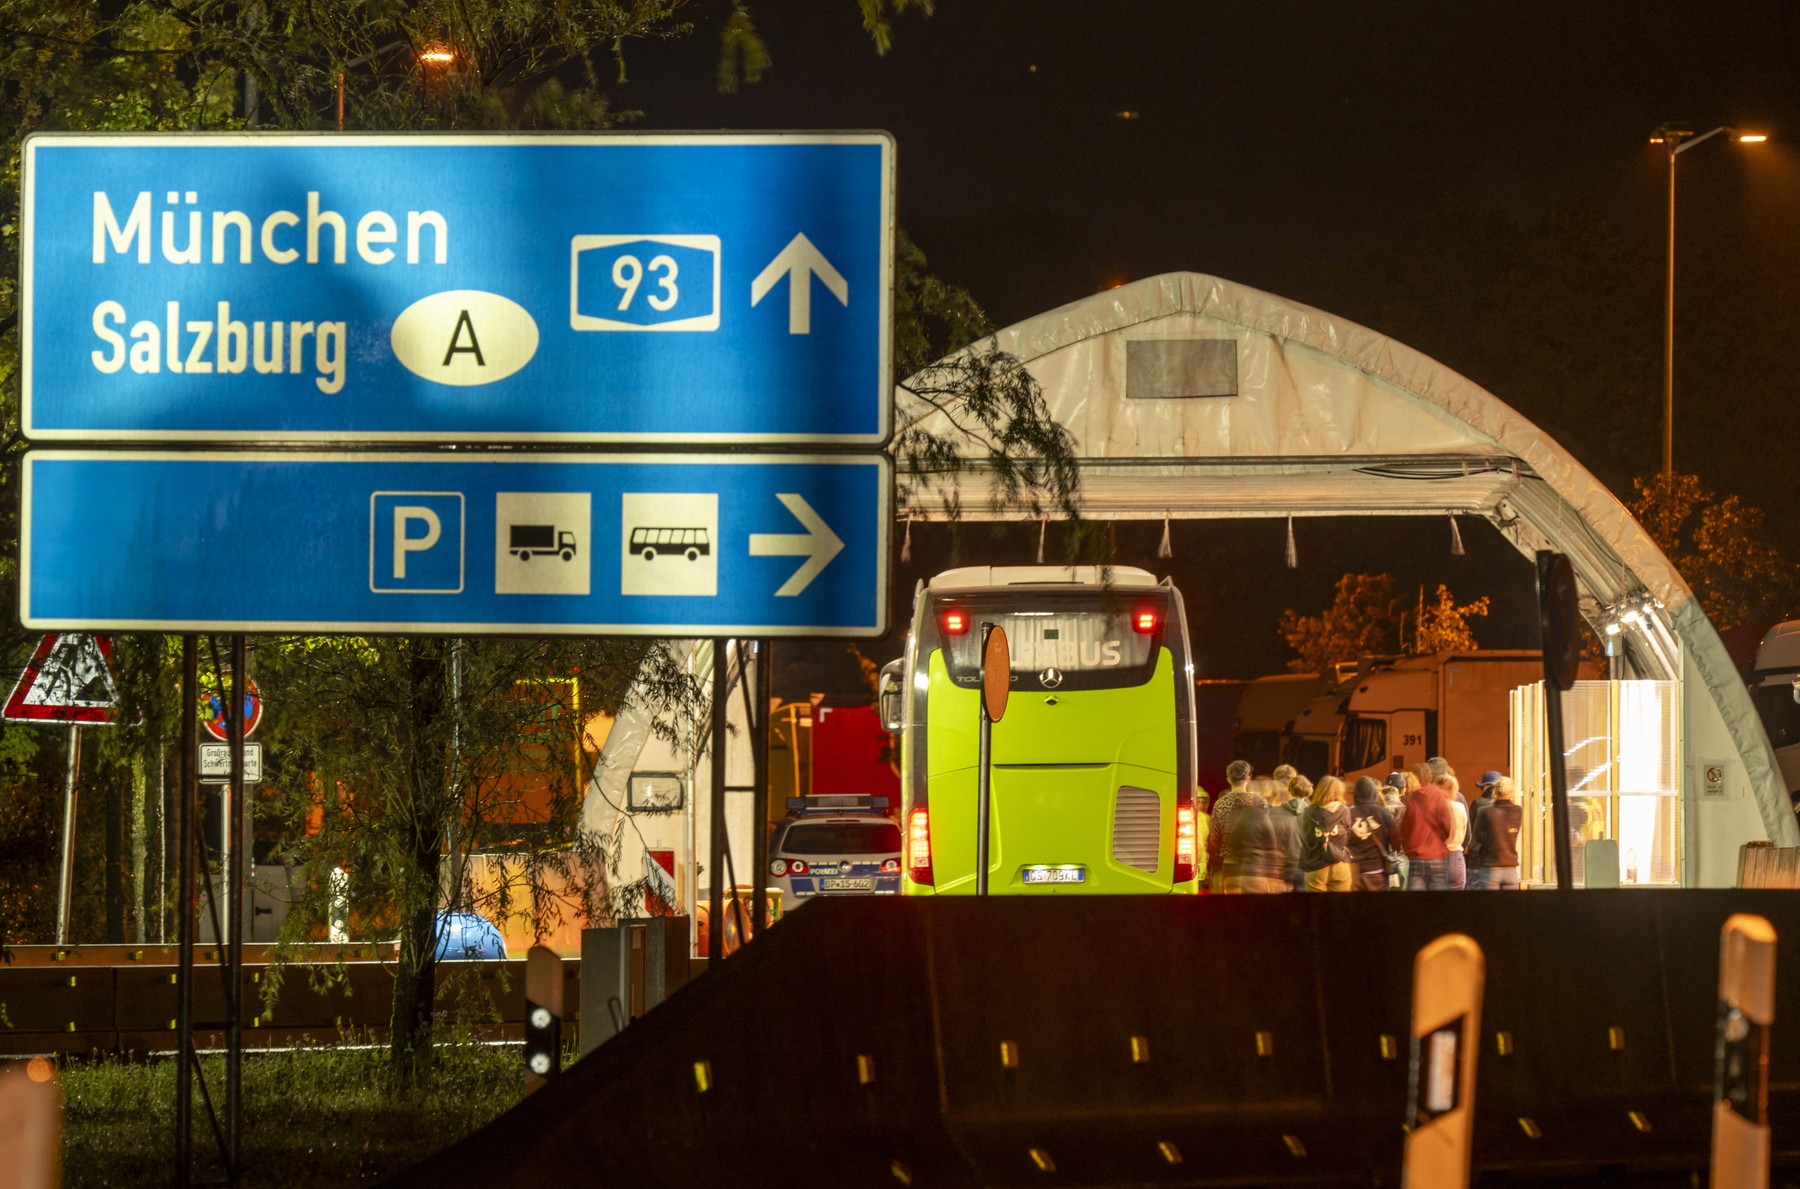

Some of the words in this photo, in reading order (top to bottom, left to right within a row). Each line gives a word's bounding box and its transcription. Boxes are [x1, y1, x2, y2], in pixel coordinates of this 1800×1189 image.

[91, 191, 448, 266] München
[612, 255, 679, 312] 93
[91, 299, 347, 395] Salzburg
[443, 310, 485, 367] A
[392, 506, 442, 579] P
[1403, 734, 1422, 746] 391
